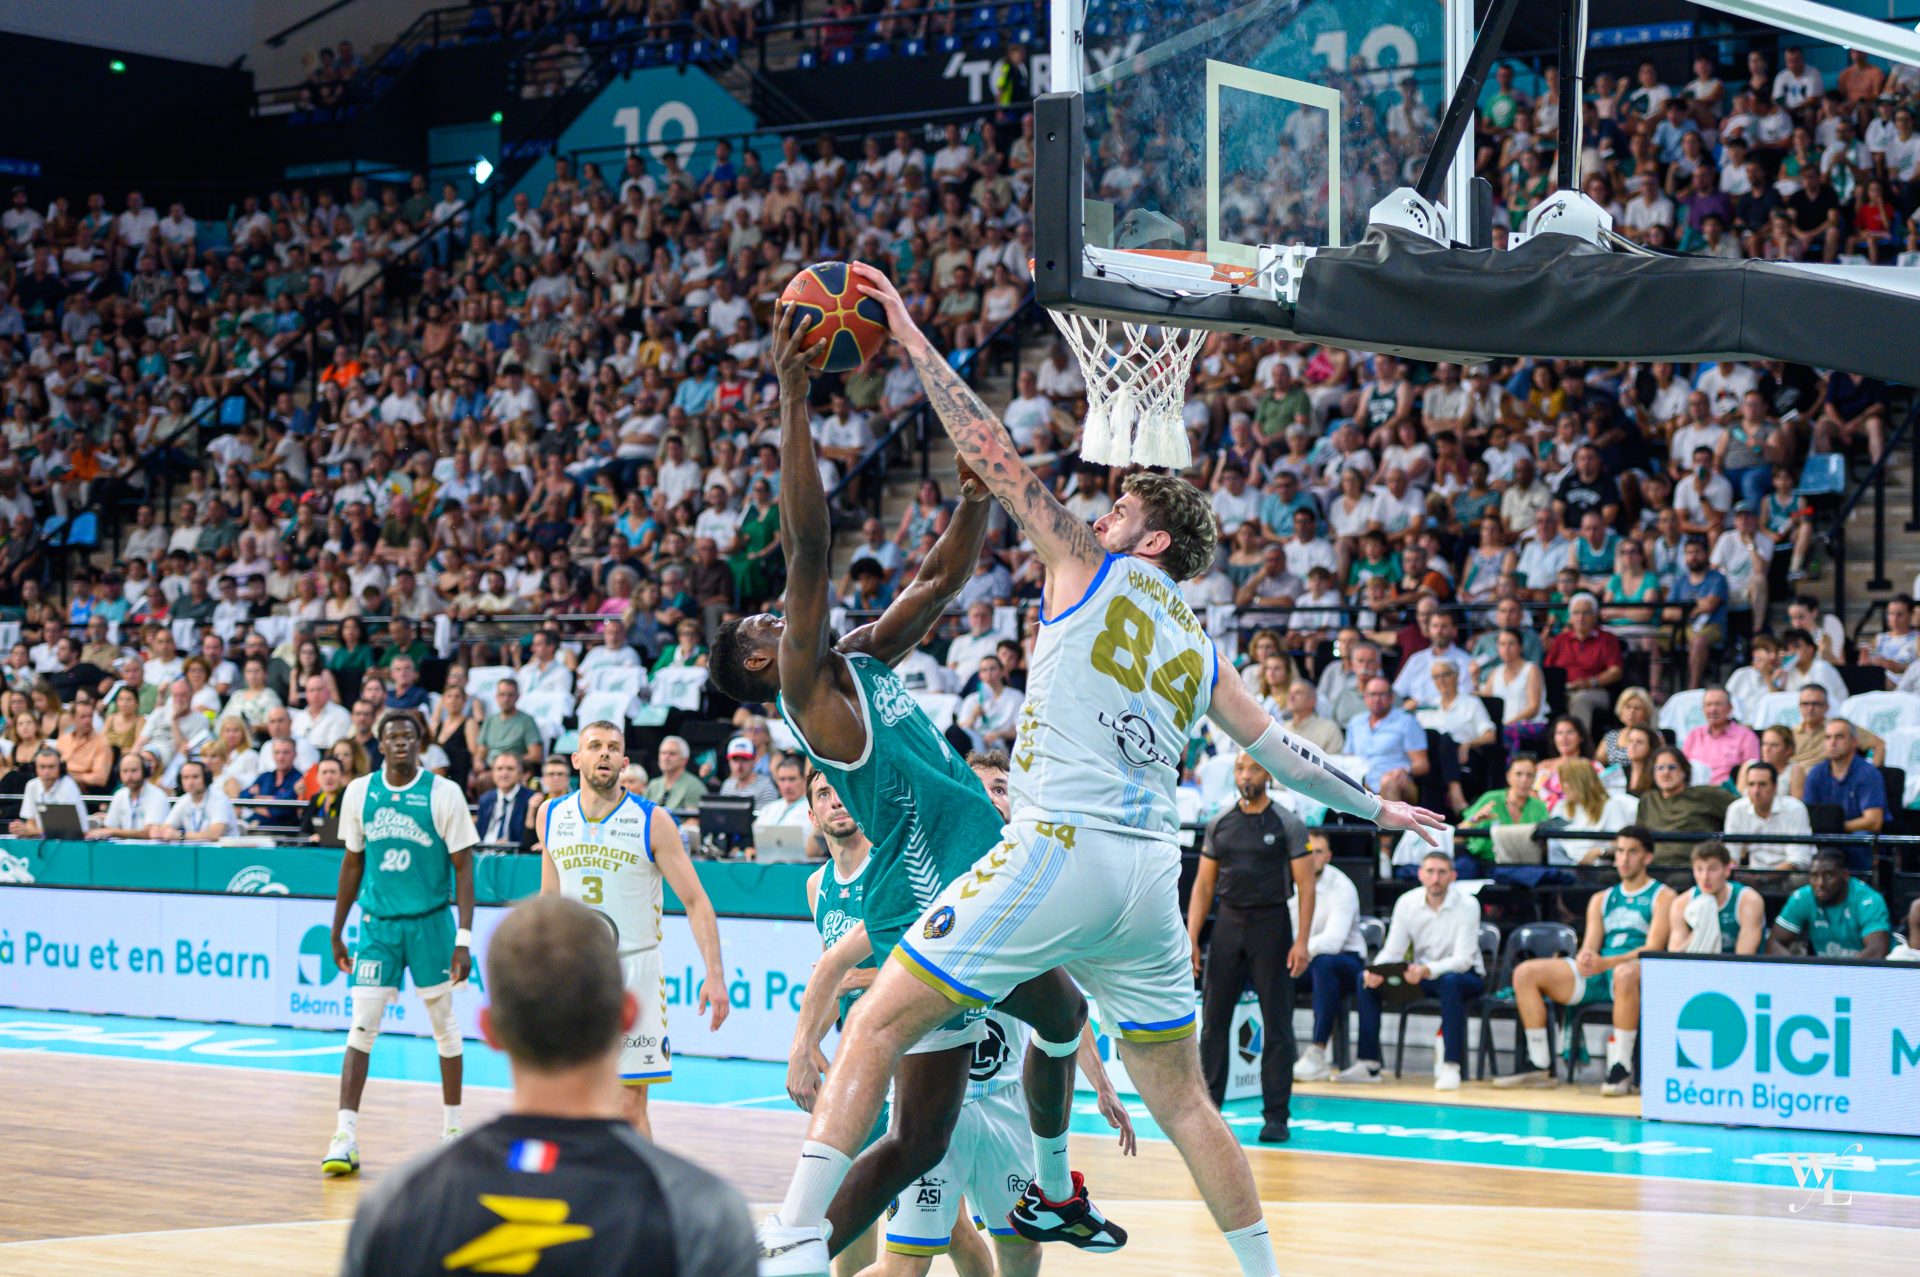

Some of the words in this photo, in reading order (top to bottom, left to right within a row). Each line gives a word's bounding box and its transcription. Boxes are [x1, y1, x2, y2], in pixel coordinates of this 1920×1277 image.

[1090, 594, 1206, 731] 84
[379, 847, 411, 872] 20
[551, 843, 640, 865] CHAMPAGNE
[562, 856, 623, 873] BASKET
[581, 875, 604, 905] 3
[25, 931, 79, 968] Pau
[89, 938, 119, 971] et
[128, 947, 164, 974] en
[175, 939, 270, 979] Béarn
[729, 967, 750, 1009] à
[290, 992, 340, 1017] Béarn
[1755, 993, 1851, 1077] ici
[1665, 1078, 1744, 1107] Béarn
[1752, 1083, 1850, 1118] Bigorre
[916, 1188, 941, 1204] ASI
